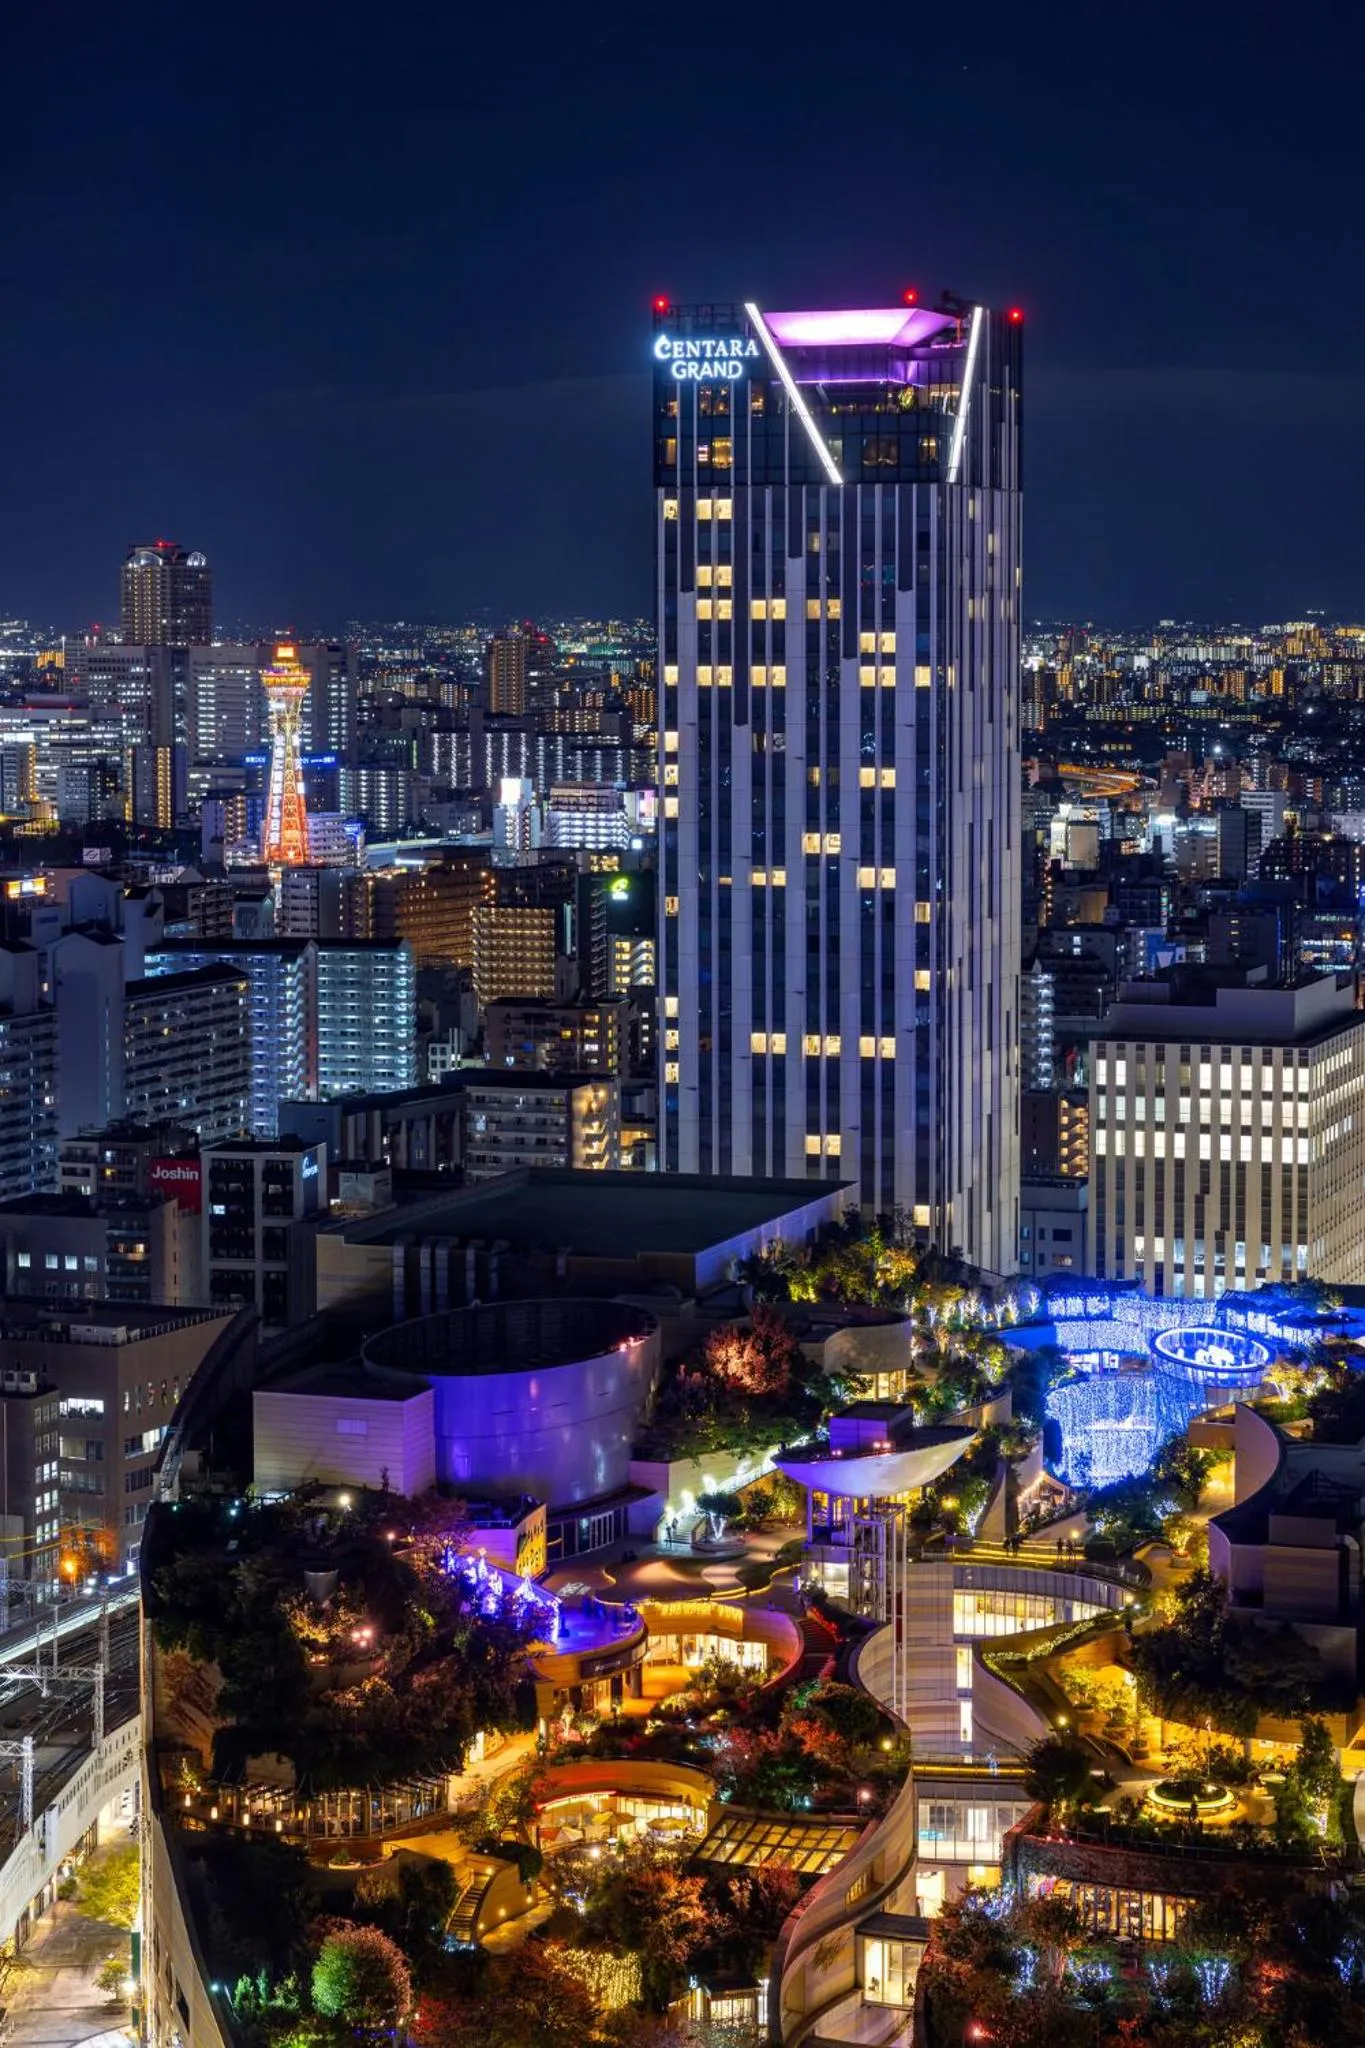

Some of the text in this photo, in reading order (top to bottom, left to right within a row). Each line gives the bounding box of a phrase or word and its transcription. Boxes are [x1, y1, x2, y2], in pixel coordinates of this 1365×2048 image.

[654, 334, 760, 360] CENTARA
[671, 360, 743, 381] GRAND
[152, 1165, 199, 1180] Joshin
